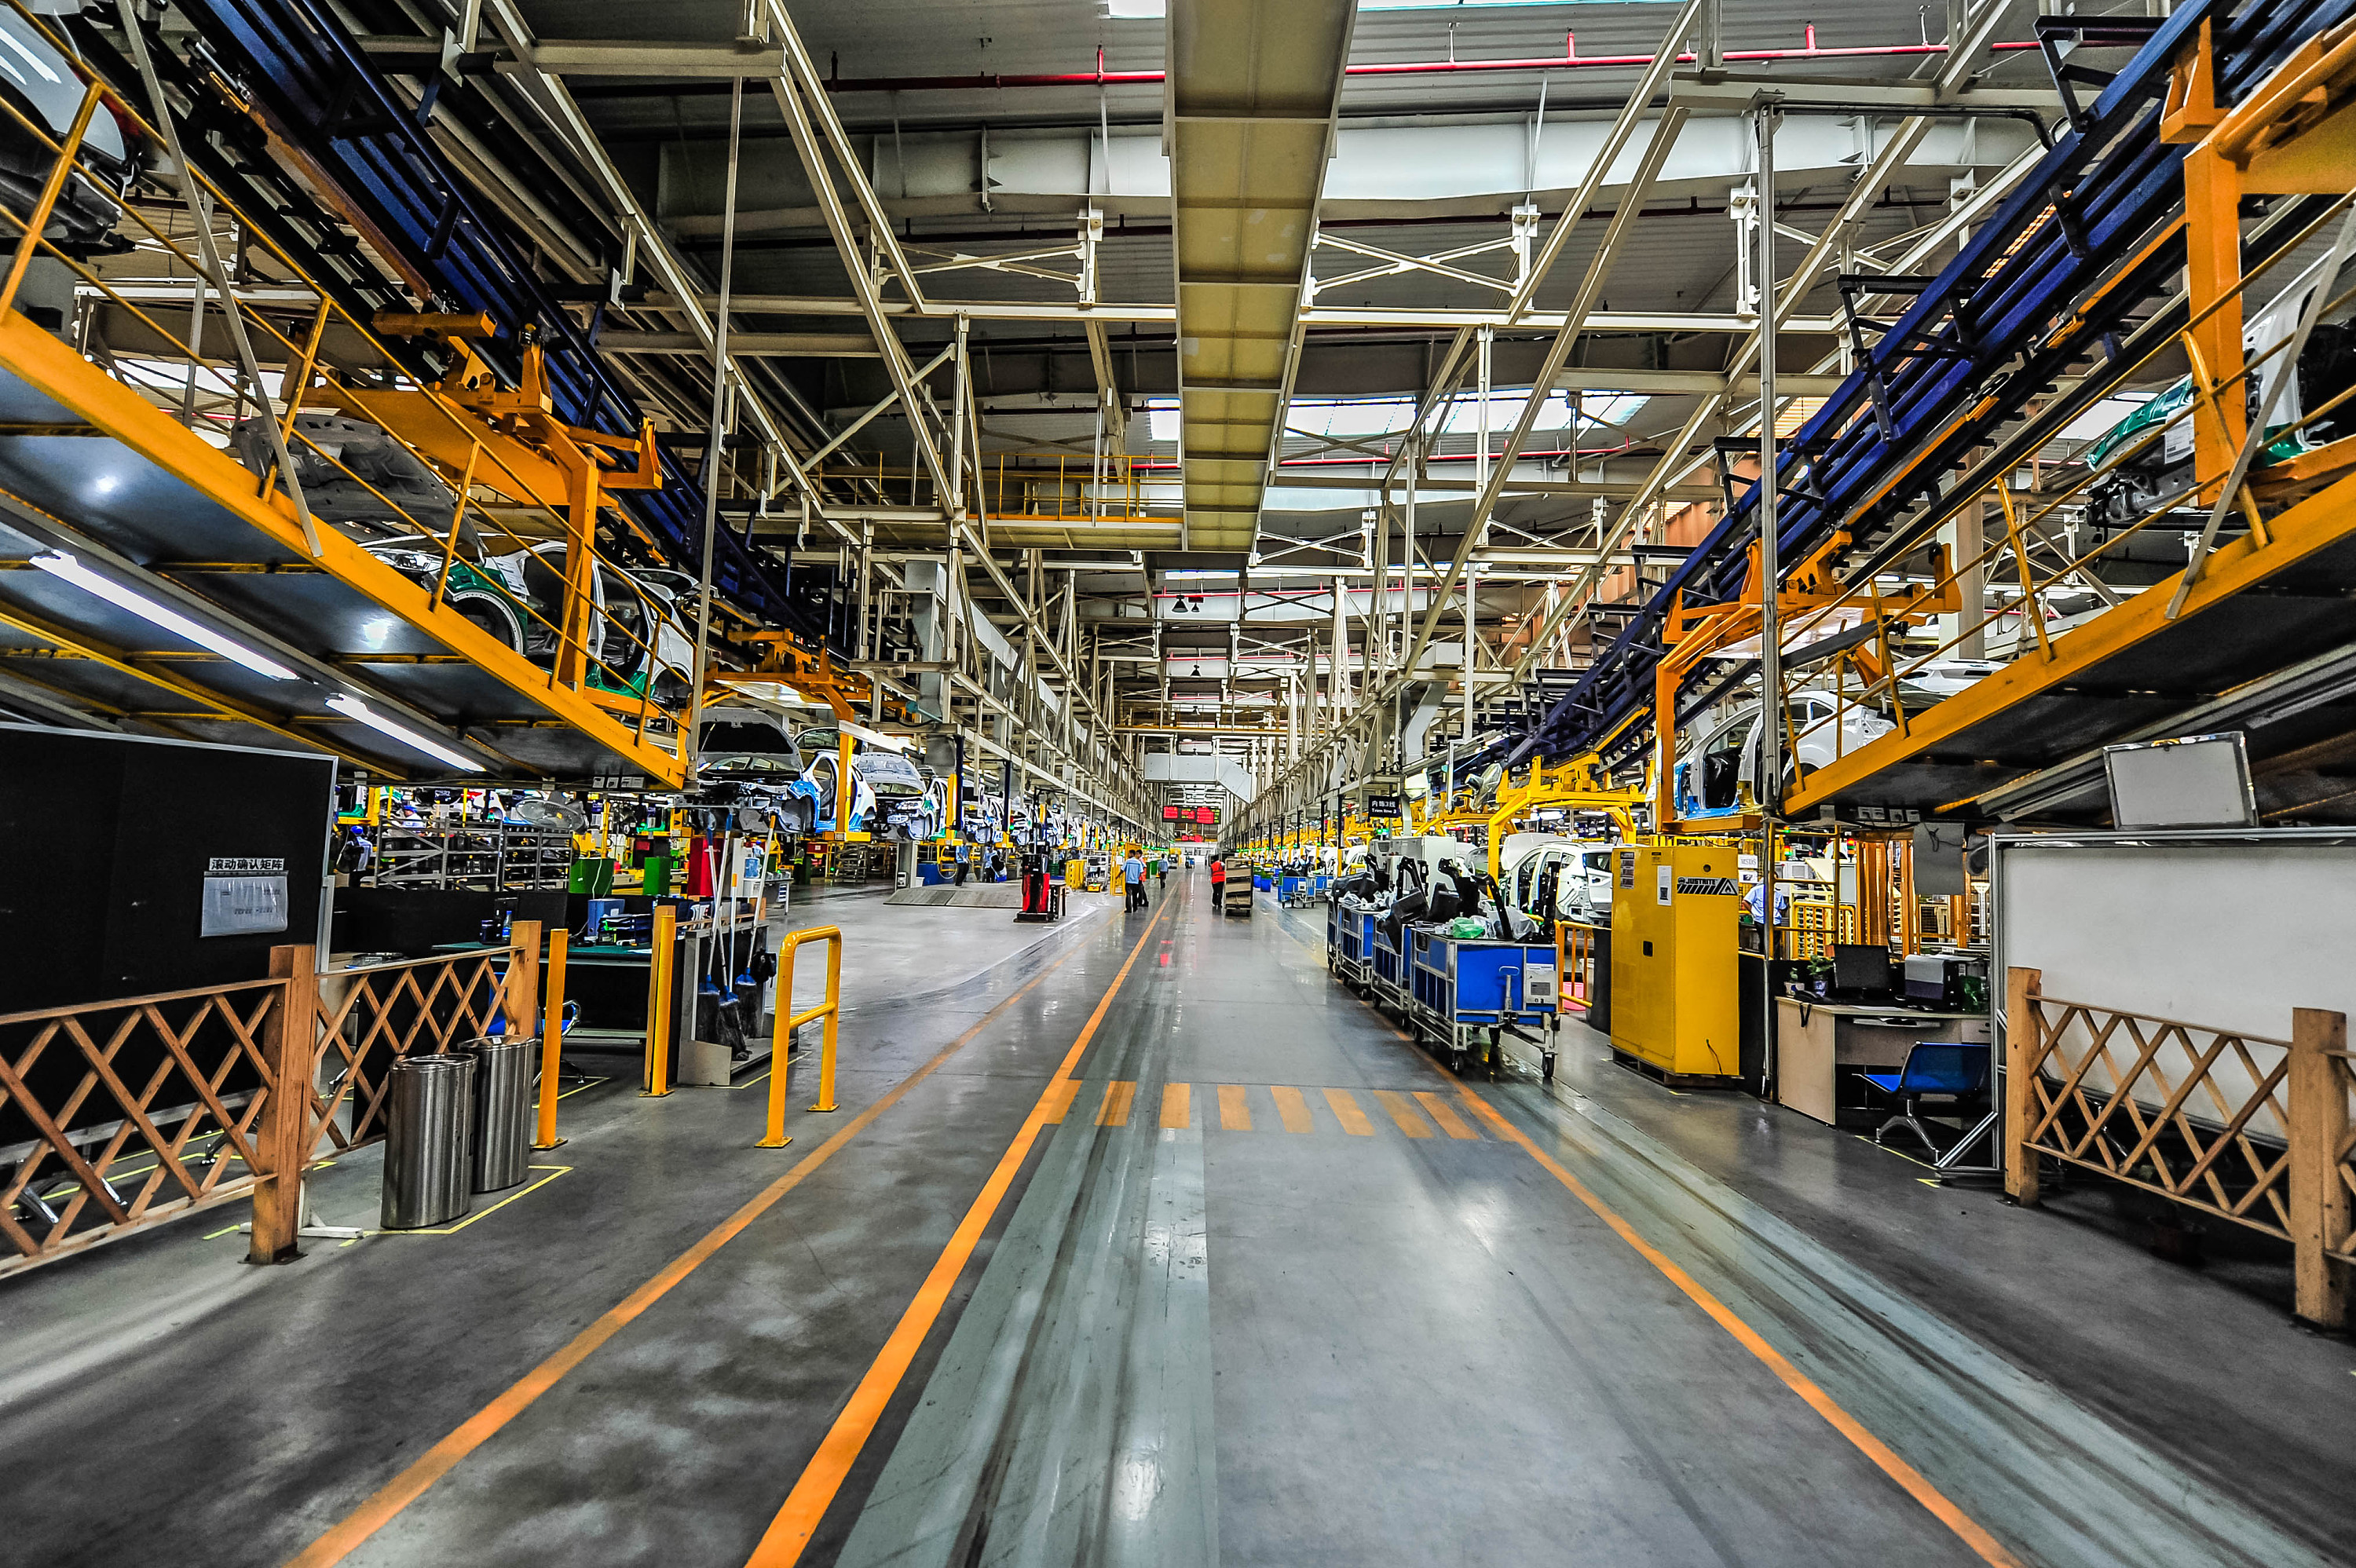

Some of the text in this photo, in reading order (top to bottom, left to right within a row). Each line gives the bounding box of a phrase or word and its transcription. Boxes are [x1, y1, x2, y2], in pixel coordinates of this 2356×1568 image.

[211, 858, 283, 871] 滚动确认矩阵
